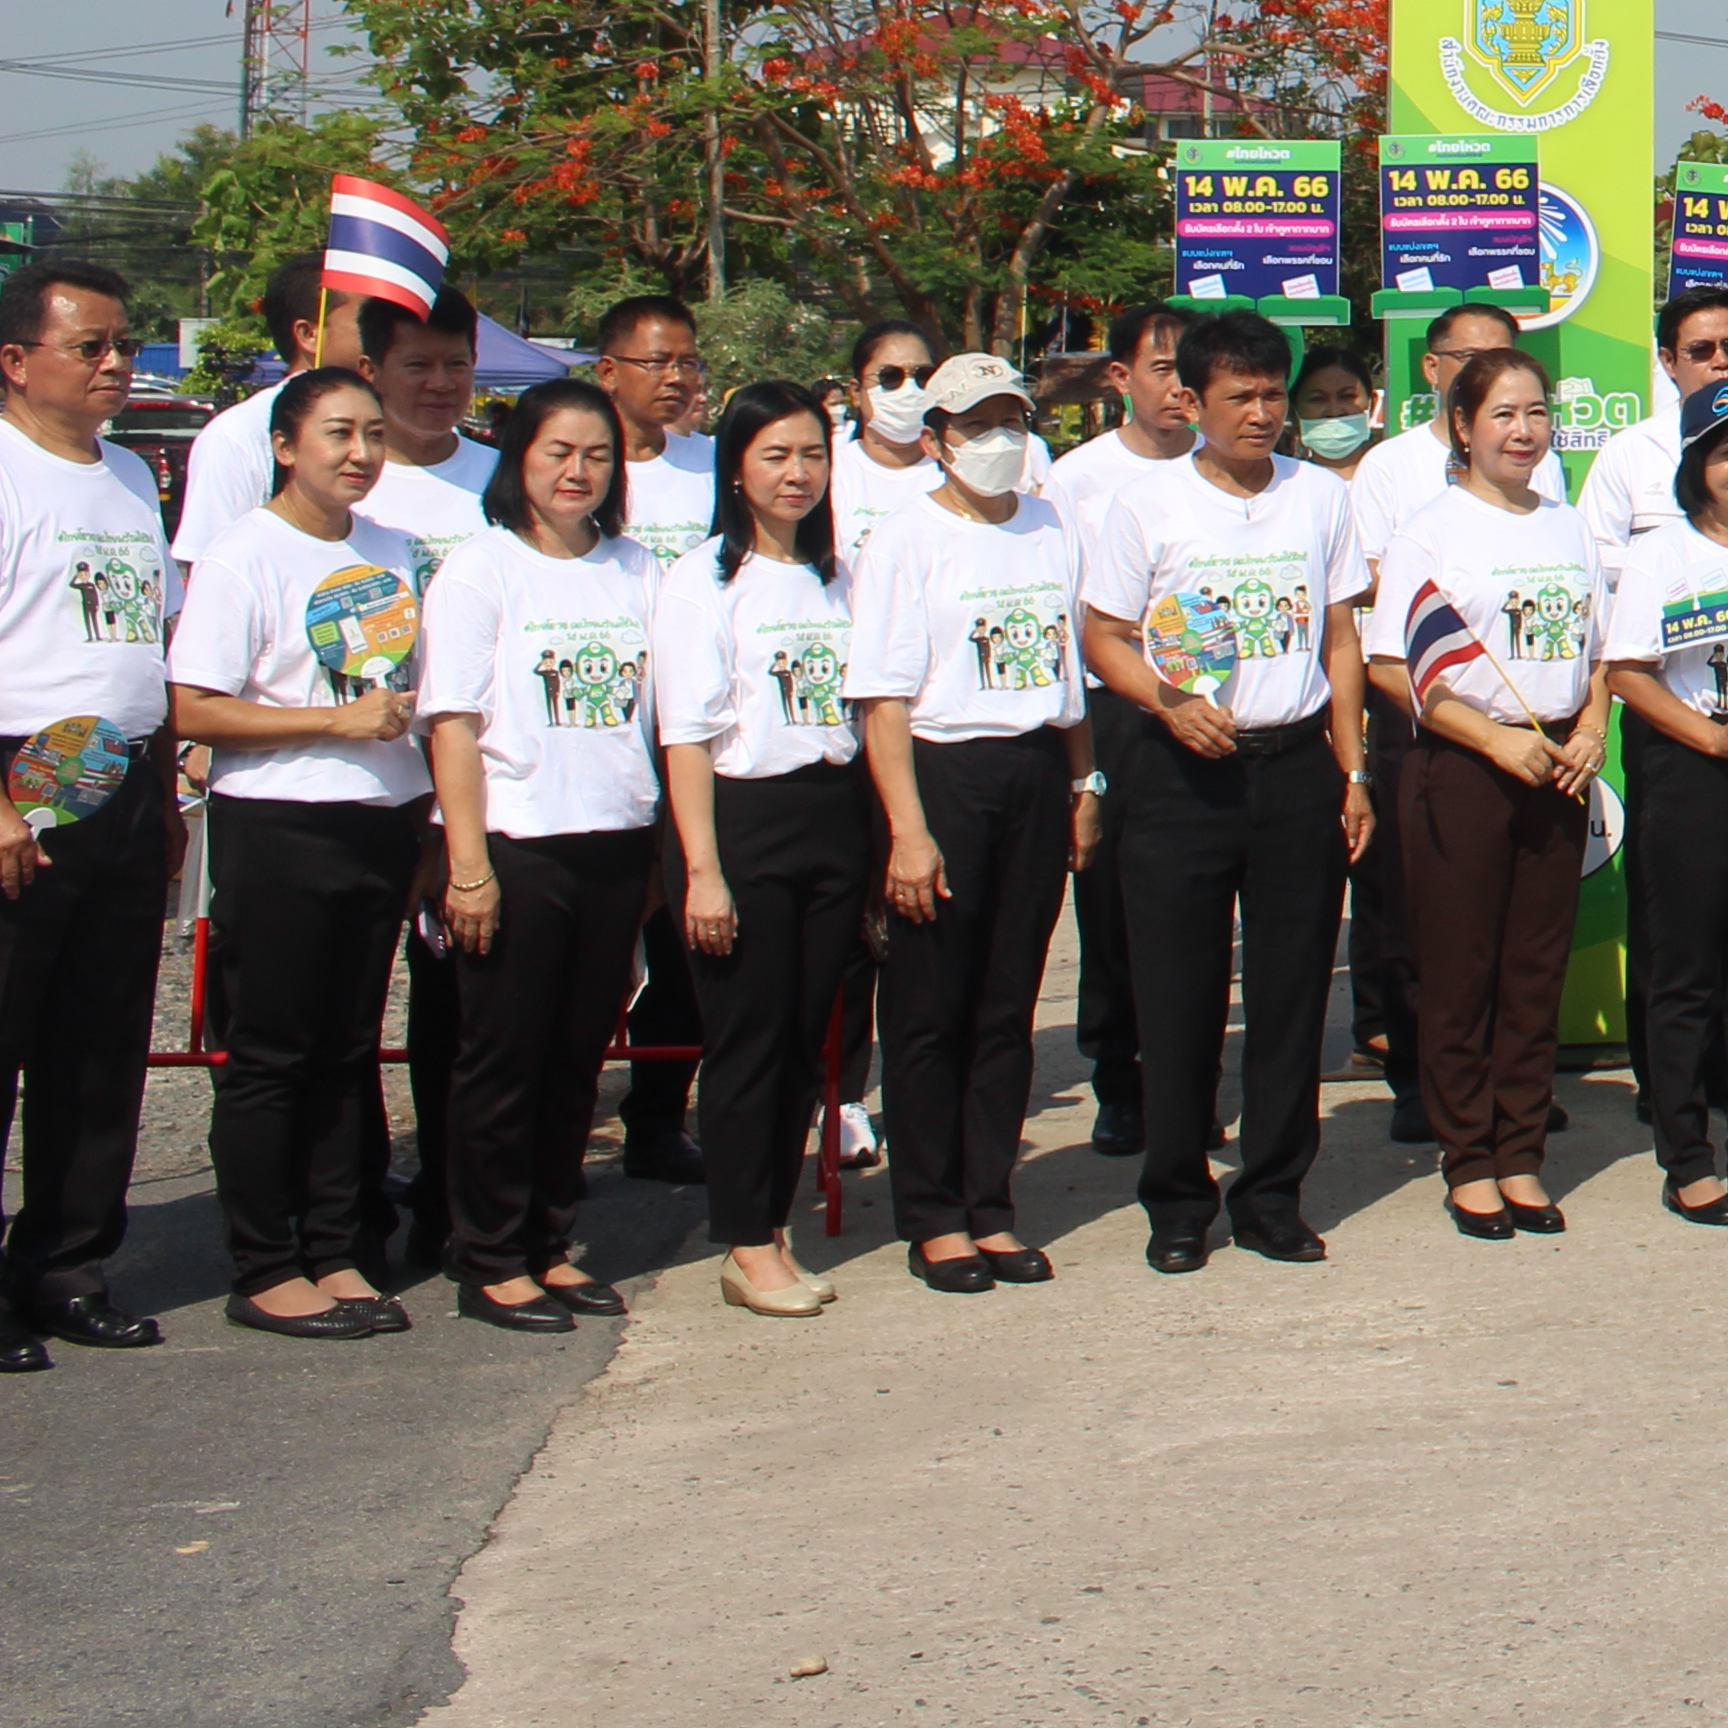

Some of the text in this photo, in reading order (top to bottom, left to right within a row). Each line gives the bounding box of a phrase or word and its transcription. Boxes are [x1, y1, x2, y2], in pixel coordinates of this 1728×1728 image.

[1184, 175, 1329, 198] 14 พ.ค. 66
[1387, 167, 1529, 191] 14 พ.ค. 66
[1188, 200, 1324, 213] เวลา 08.00-17.00 น.
[1393, 193, 1526, 207] เวลา 08.00-17.00 น.
[1680, 195, 1710, 219] 14
[1666, 621, 1680, 634] 14
[1682, 614, 1713, 630] พ.ค.
[1590, 820, 1612, 837] น.
